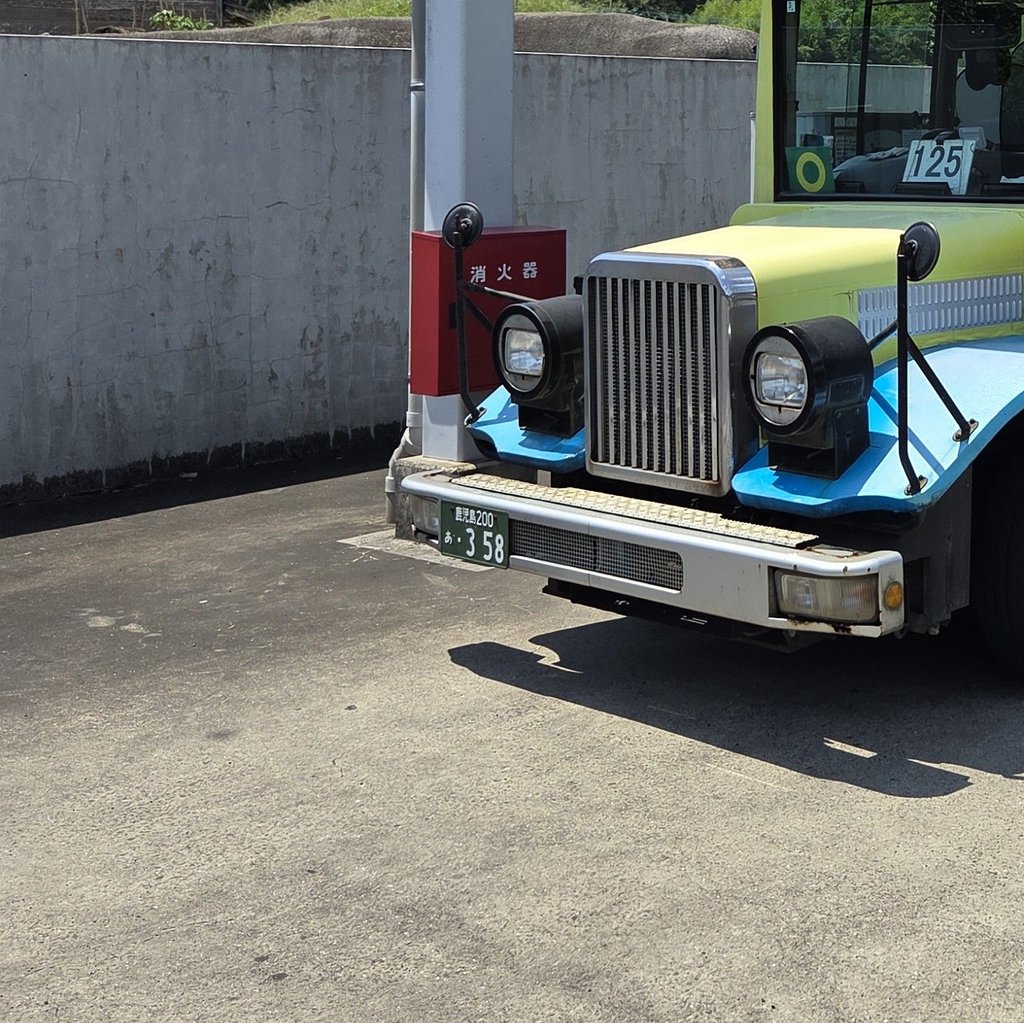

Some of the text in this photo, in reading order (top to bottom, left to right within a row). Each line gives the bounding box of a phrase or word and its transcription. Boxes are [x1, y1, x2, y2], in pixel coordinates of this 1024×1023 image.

[913, 145, 963, 178] 125
[470, 261, 538, 283] 消火器
